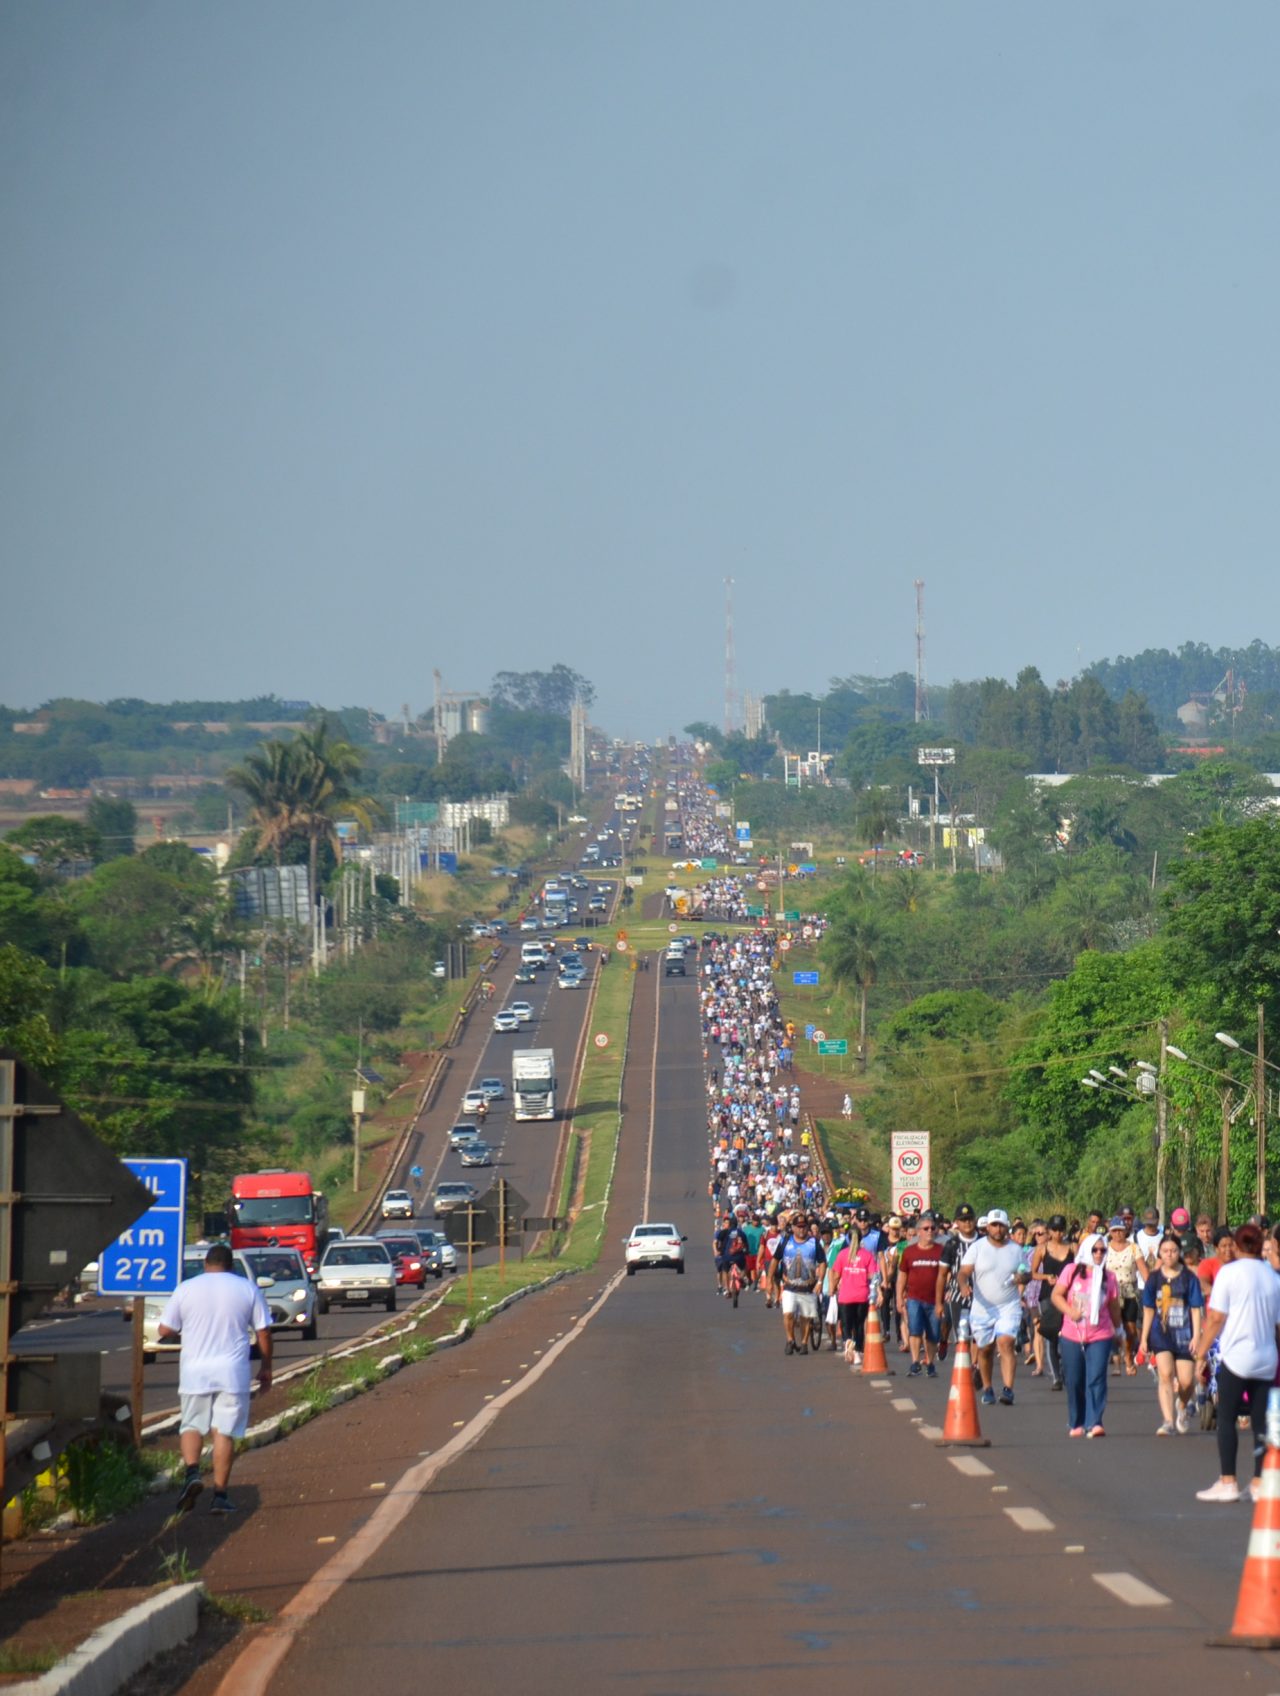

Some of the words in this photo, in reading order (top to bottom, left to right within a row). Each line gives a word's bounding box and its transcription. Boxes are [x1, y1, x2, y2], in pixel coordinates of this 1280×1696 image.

[902, 1156, 920, 1166] 100
[902, 1197, 920, 1208] 80
[118, 1228, 165, 1246] km
[115, 1257, 167, 1281] 272
